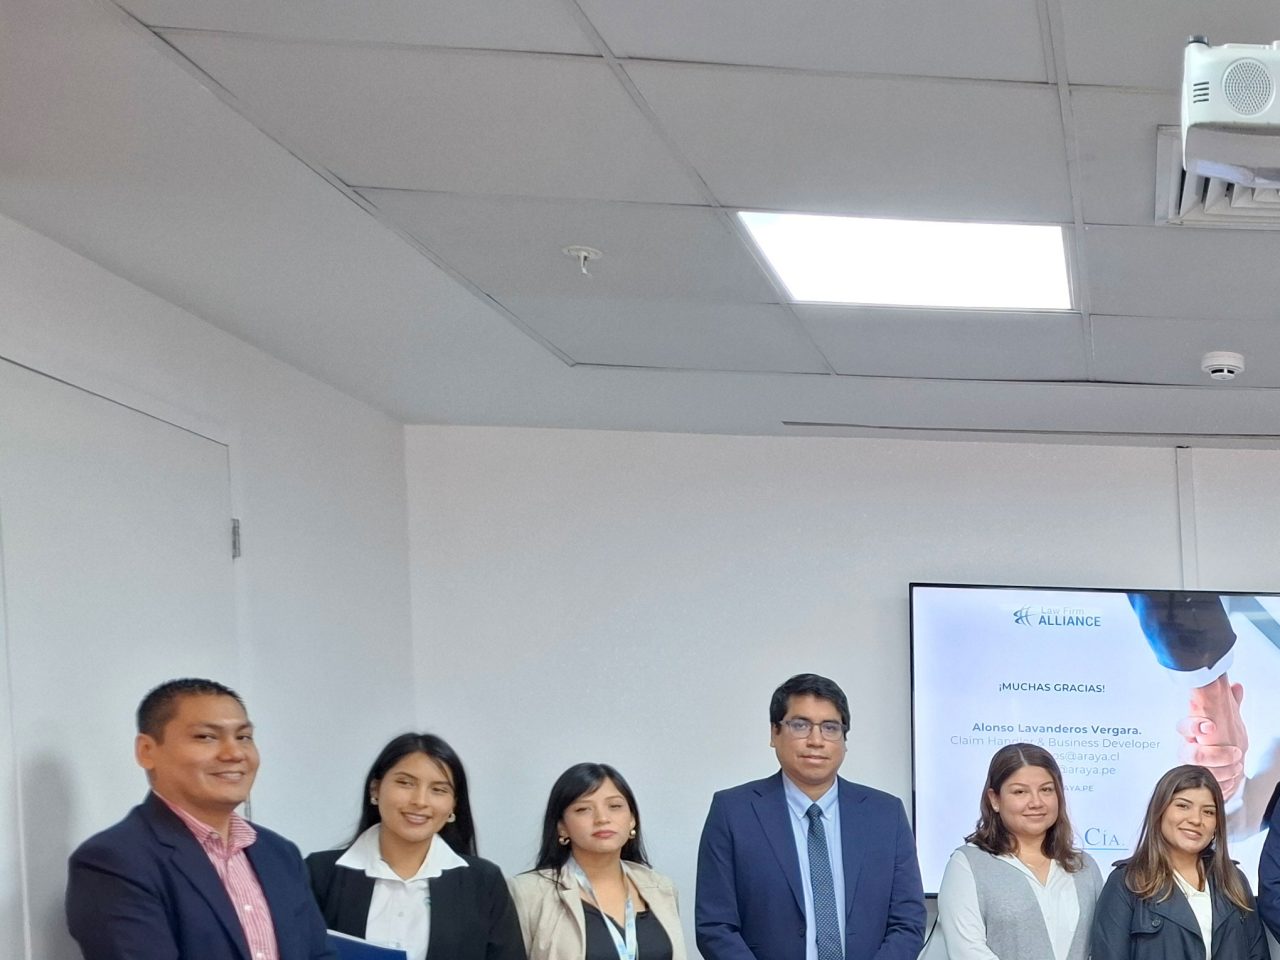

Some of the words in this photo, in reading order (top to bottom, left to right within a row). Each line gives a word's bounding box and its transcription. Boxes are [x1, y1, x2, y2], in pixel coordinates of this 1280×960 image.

[1041, 606, 1060, 615] Law
[1063, 607, 1085, 616] Firm
[1038, 615, 1101, 627] ALLIANCE
[999, 682, 1051, 692] ¡MUCHAS
[1054, 683, 1105, 693] GRACIAS!
[972, 722, 1014, 733] Alonso
[1018, 724, 1088, 734] Lavanderos
[1091, 725, 1142, 736] Vergara.
[950, 735, 984, 745] Claim
[1037, 737, 1045, 746] &
[1049, 737, 1099, 748] Business
[1102, 739, 1160, 750] Developer
[1054, 751, 1120, 763] os@araya.cl
[1060, 765, 1116, 776] @araya.pe
